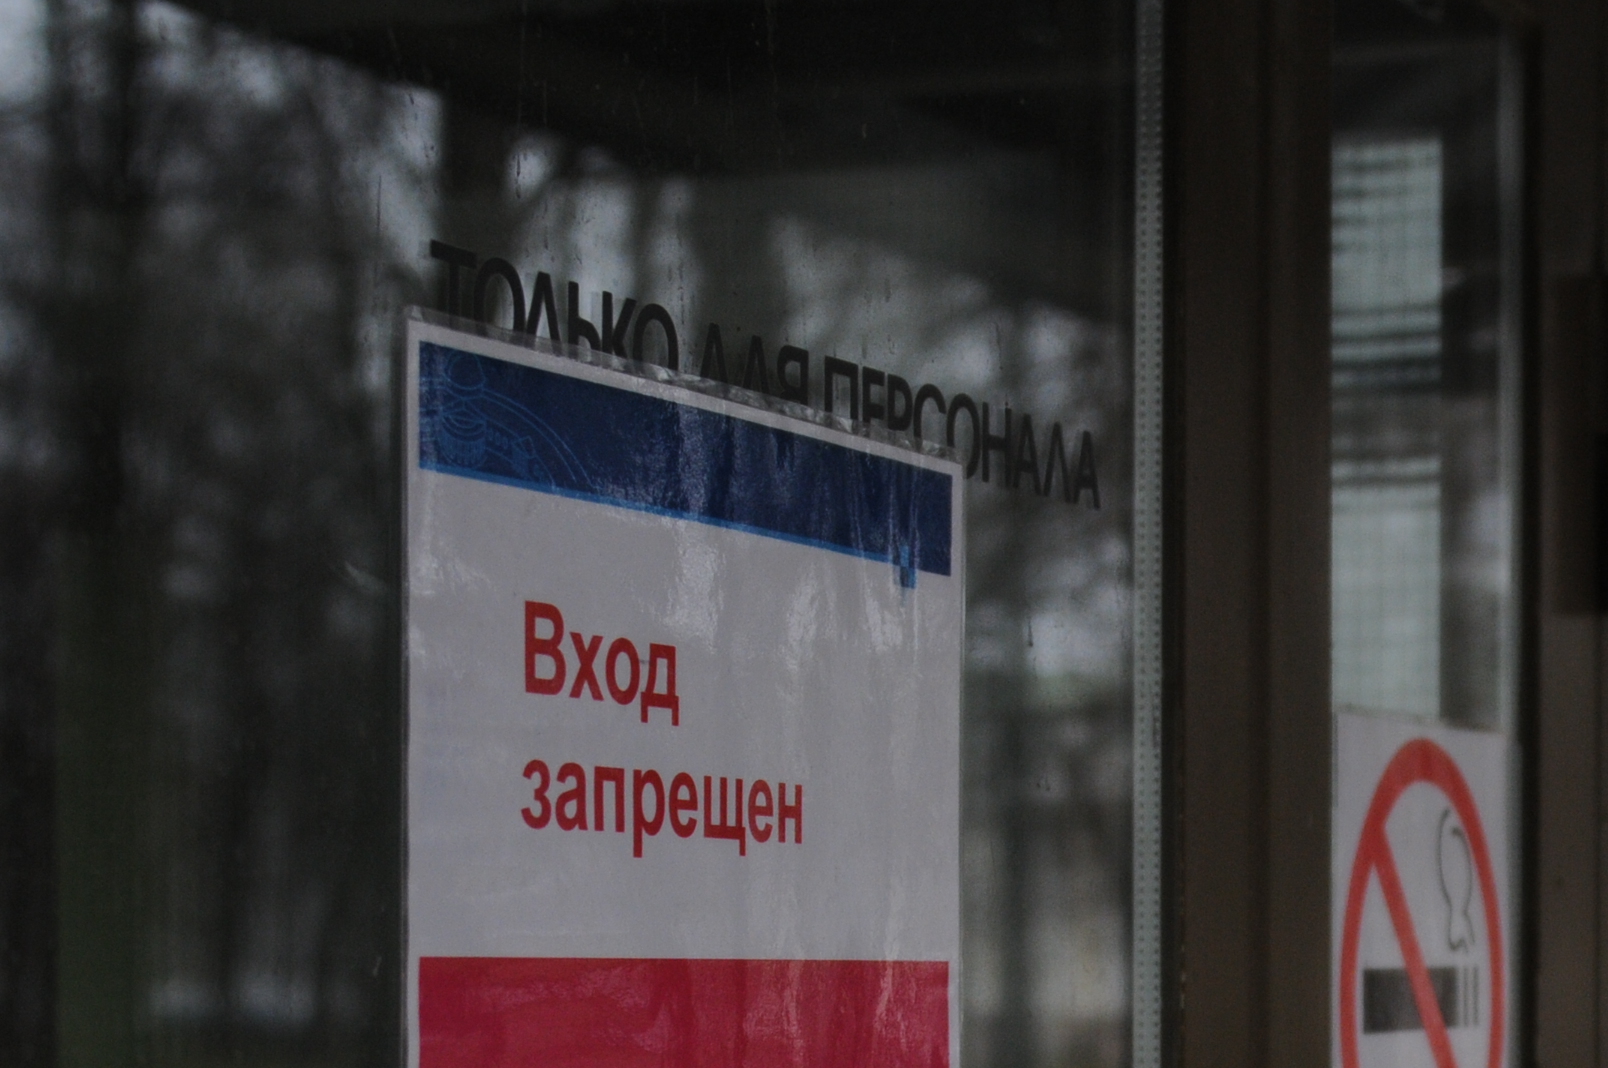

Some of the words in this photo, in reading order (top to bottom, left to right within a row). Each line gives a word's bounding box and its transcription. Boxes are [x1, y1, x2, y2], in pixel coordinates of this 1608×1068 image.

[429, 238, 680, 376] ТОЛЬКО
[824, 355, 1101, 510] ПЕРСОНАЛА
[523, 599, 680, 727] Вход
[520, 758, 803, 858] запрещен
